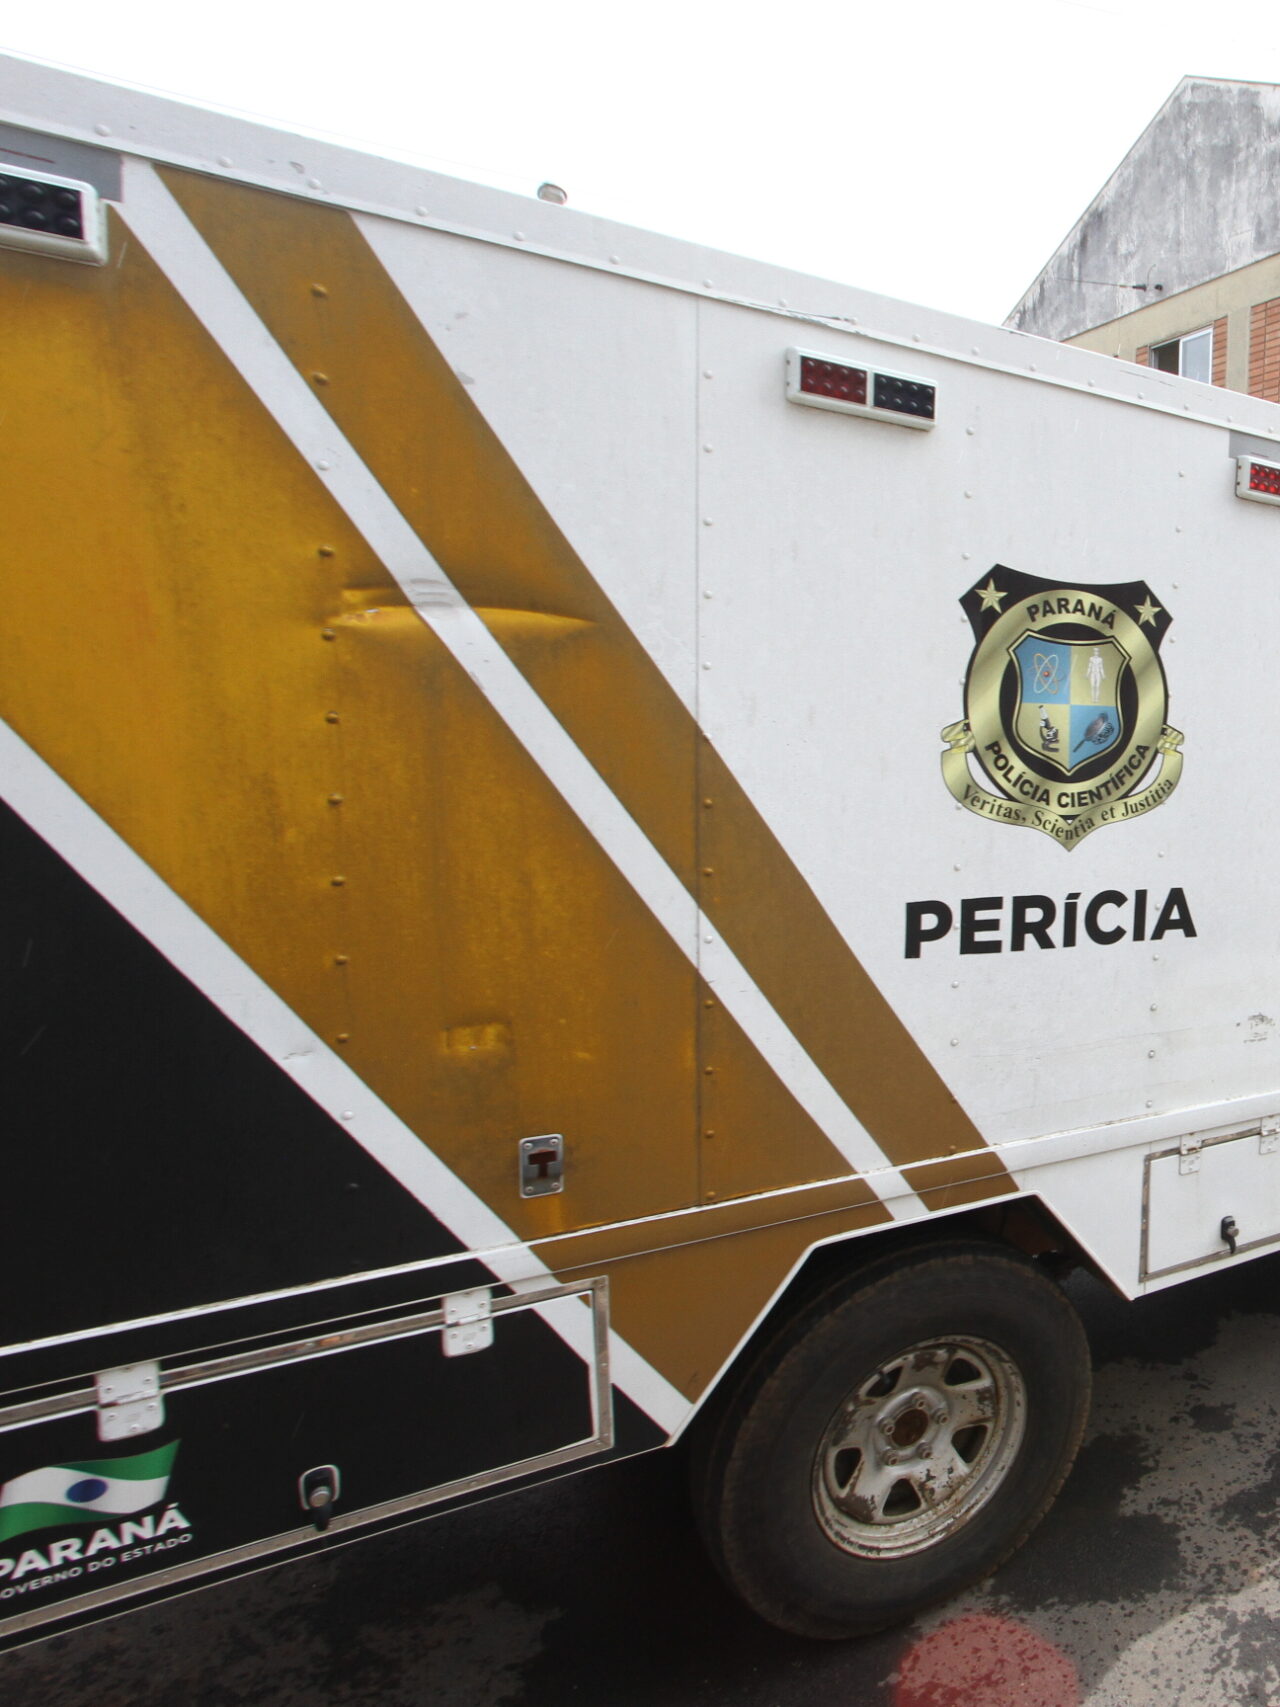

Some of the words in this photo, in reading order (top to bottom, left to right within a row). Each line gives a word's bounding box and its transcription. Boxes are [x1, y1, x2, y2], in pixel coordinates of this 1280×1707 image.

[1026, 597, 1116, 630] PARANÁ
[985, 741, 1050, 806] POLÍCIA
[1057, 744, 1149, 808] CIENTÍFICA
[963, 784, 1026, 823] Veritas,
[1031, 810, 1096, 841] Scientia
[1101, 805, 1115, 821] et
[1122, 778, 1174, 817] Justitia
[904, 887, 1198, 959] PERÍCIA
[87, 1556, 116, 1572] DO
[121, 1533, 193, 1562] ESTADO
